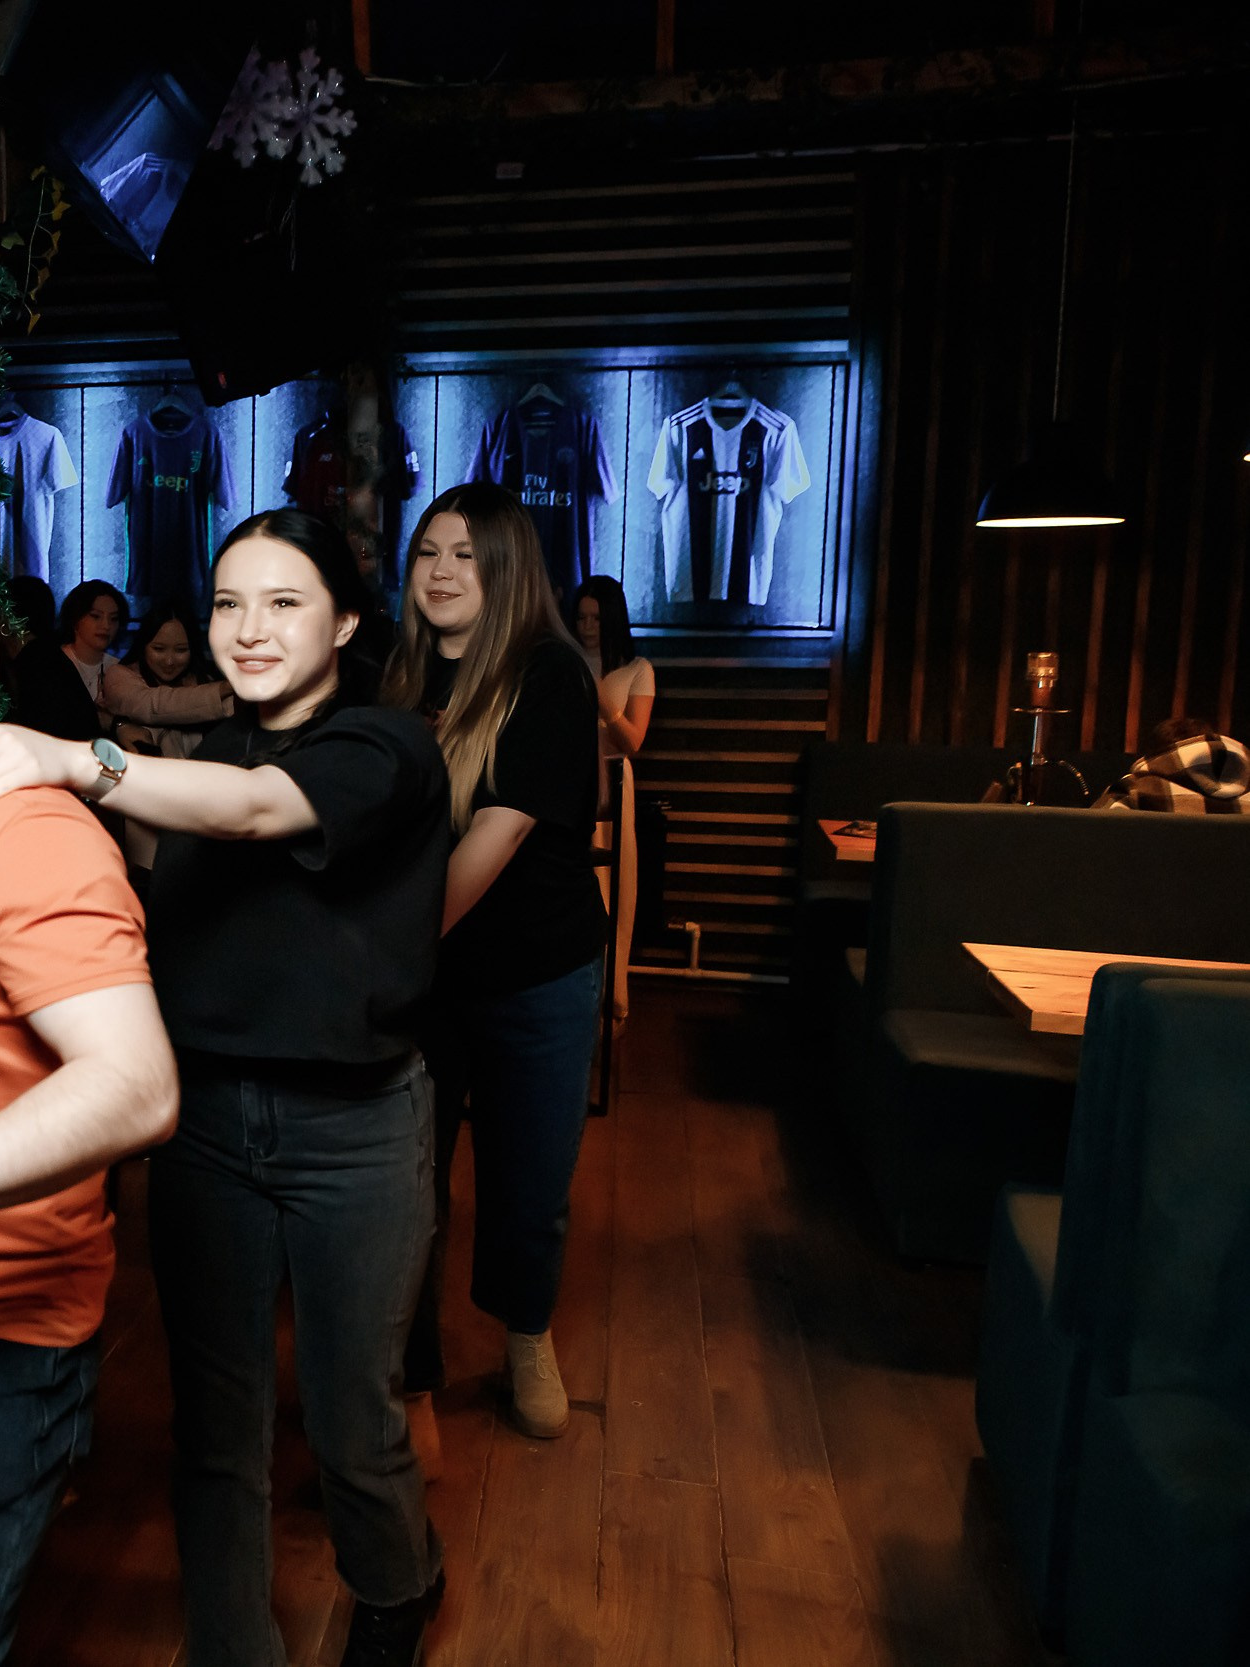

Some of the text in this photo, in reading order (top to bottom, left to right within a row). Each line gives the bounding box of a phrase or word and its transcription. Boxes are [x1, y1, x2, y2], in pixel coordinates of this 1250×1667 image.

[525, 474, 548, 489] Fly
[698, 472, 751, 497] Jeep
[520, 487, 573, 507] irates
